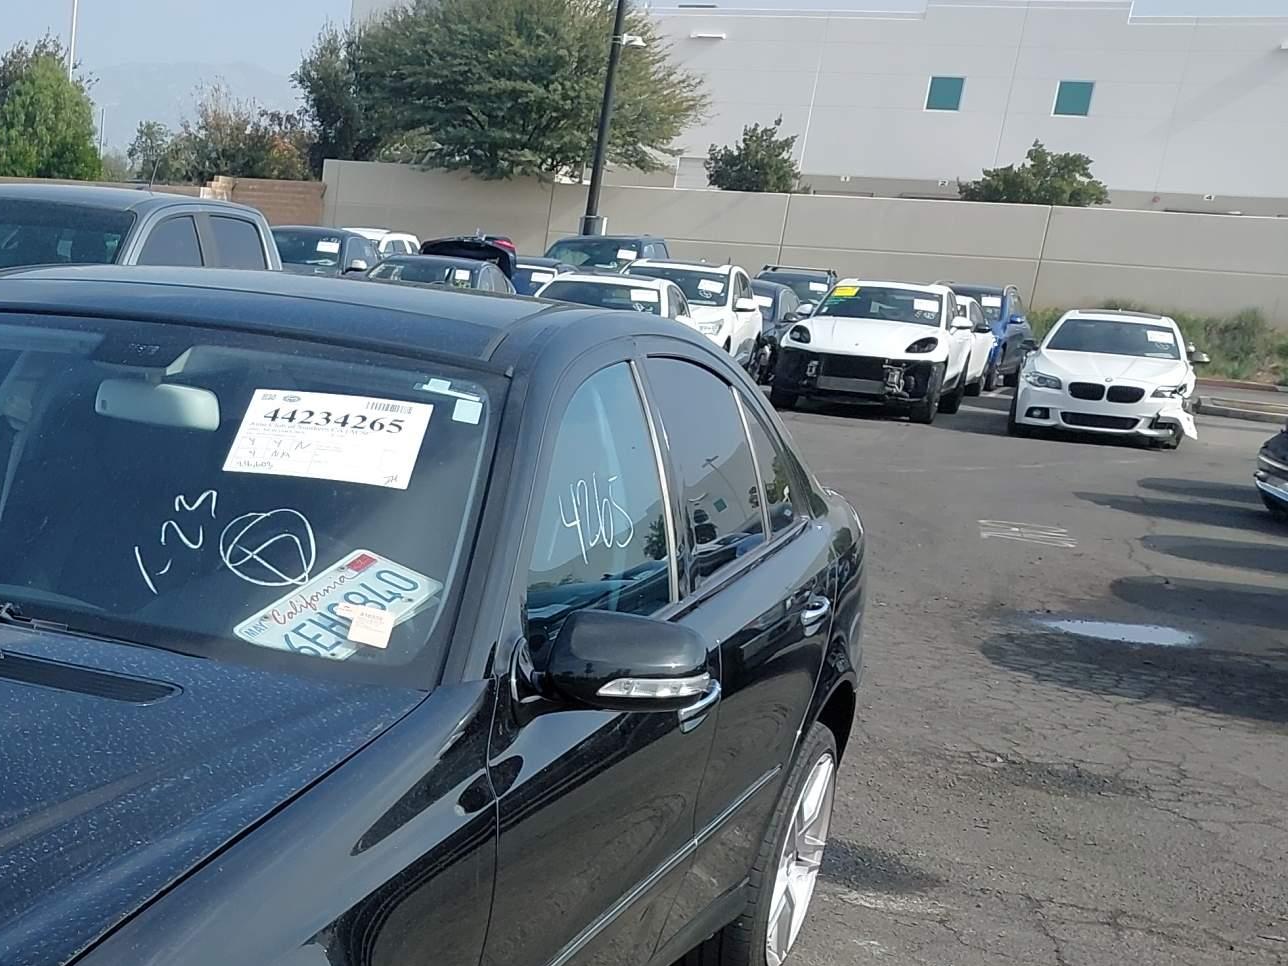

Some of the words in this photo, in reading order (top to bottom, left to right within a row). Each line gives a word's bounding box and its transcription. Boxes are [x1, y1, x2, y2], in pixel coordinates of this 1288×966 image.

[263, 407, 405, 434] 44234265
[135, 490, 217, 594] 1-23
[558, 472, 633, 564] 4265
[244, 619, 268, 639] MAY
[271, 572, 354, 625] California
